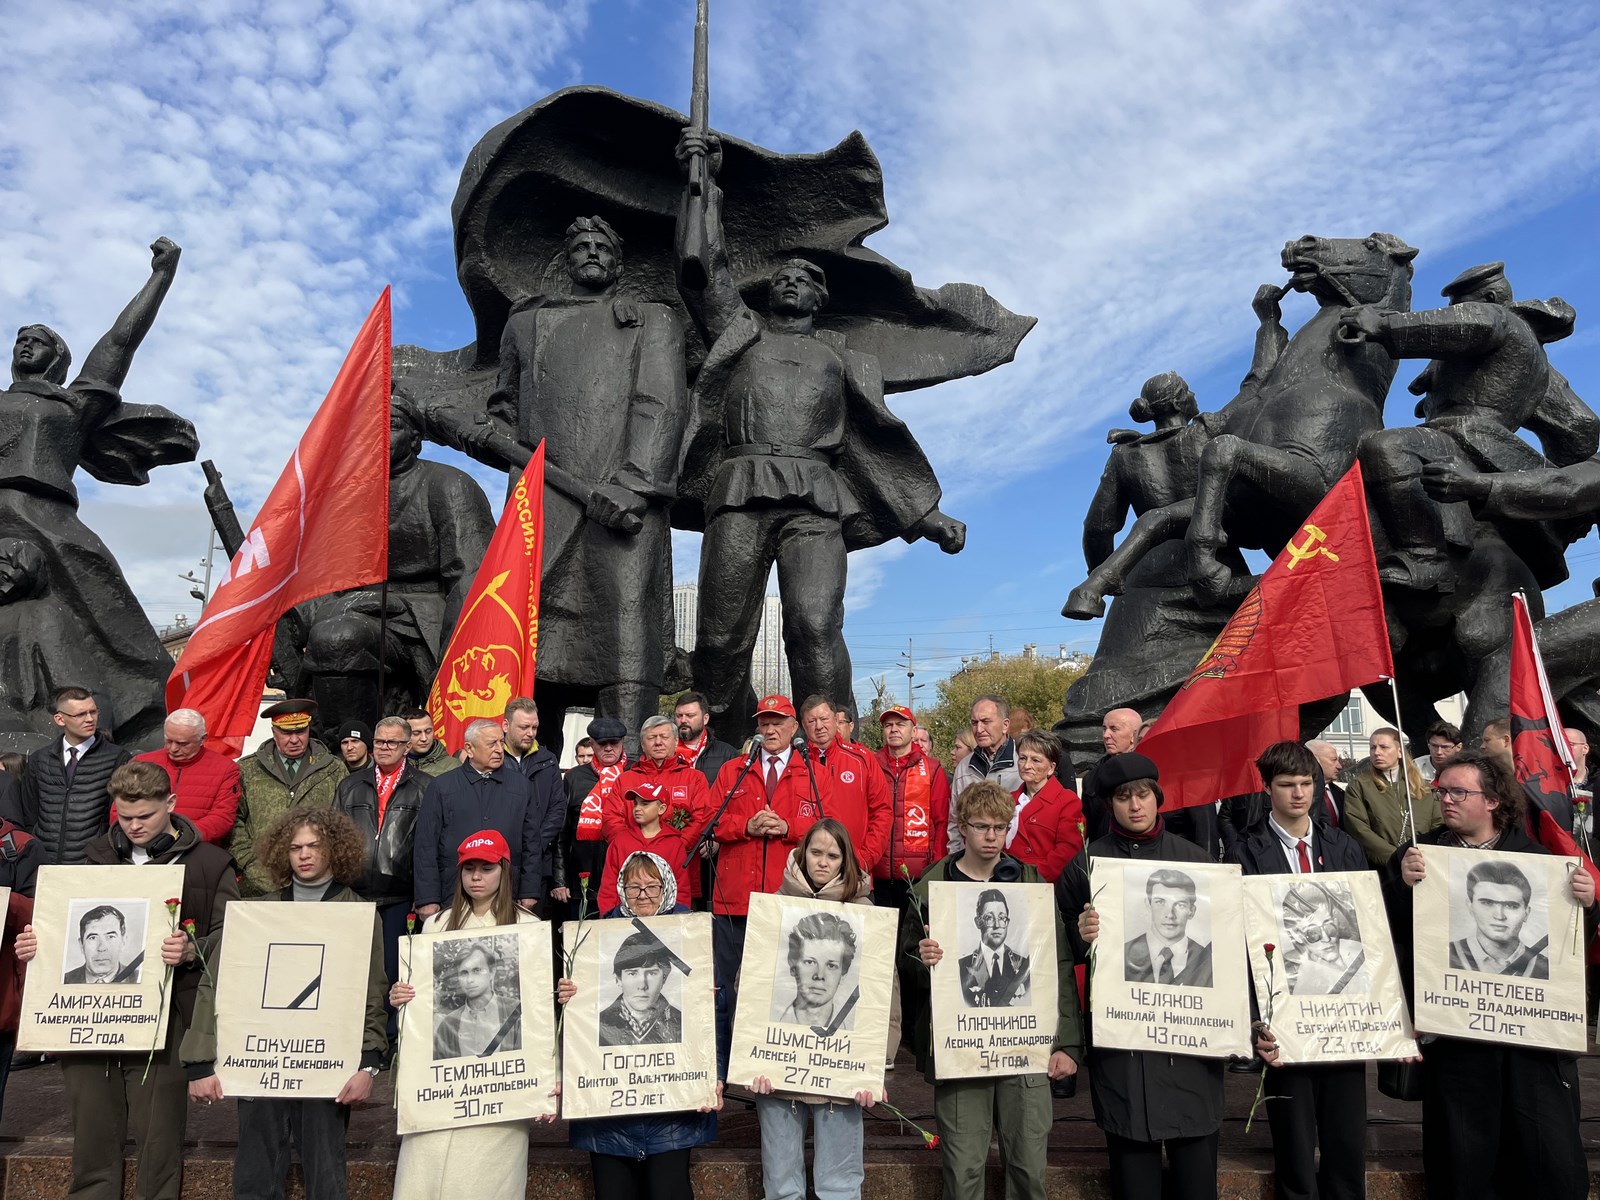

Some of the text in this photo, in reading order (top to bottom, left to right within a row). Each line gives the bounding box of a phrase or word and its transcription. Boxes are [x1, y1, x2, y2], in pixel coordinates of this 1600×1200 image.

[579, 817, 602, 825] КПРФ
[907, 829, 928, 837] КПРФ
[465, 838, 494, 849] КПРФ
[1444, 973, 1545, 1003] ПАНТЕЛЕЕВ
[48, 993, 143, 1009] АМИРХАНОВ
[1131, 987, 1203, 1010] ЧЕЛЯКОВ
[1424, 990, 1584, 1024] ИГОРЬ ВЛАДИМИРОВИЧ
[34, 1012, 158, 1024] ТАМЕРЛАН ШАРИФОВИЧ
[1106, 1006, 1234, 1029] НИКОЛАЙ НИКОЛАЕВИЧ
[1300, 1000, 1383, 1018] НИКИТИН
[957, 1014, 1037, 1032] КЛЮЧНИКОВ
[1469, 1012, 1496, 1033] 20
[70, 1028, 94, 1044] 62
[245, 1035, 326, 1054] СОКУШЕВ
[766, 1026, 851, 1054] ШУМСКИЙ
[944, 1036, 984, 1049] ЛЕОНИД
[1146, 1025, 1168, 1045] 43
[1317, 1036, 1345, 1053] 23
[223, 1055, 344, 1070] АНАТОЛИЙ СЕМЕНОВИЧ
[603, 1052, 676, 1071] ГОГОЛЕВ
[750, 1046, 866, 1072] АЛЕКСЕЙ ЮРЬЕВИЧ
[980, 1050, 1000, 1069] 54
[430, 1058, 526, 1083] ТЕМЛЯНЦЕВ
[784, 1066, 810, 1086] 27
[260, 1072, 280, 1090] 48
[417, 1077, 538, 1103] ЮРИЙ АНАТОЛЬЕВИЧ
[578, 1076, 619, 1089] ВИКТОР
[610, 1089, 637, 1108] 26
[453, 1098, 480, 1119] 30
